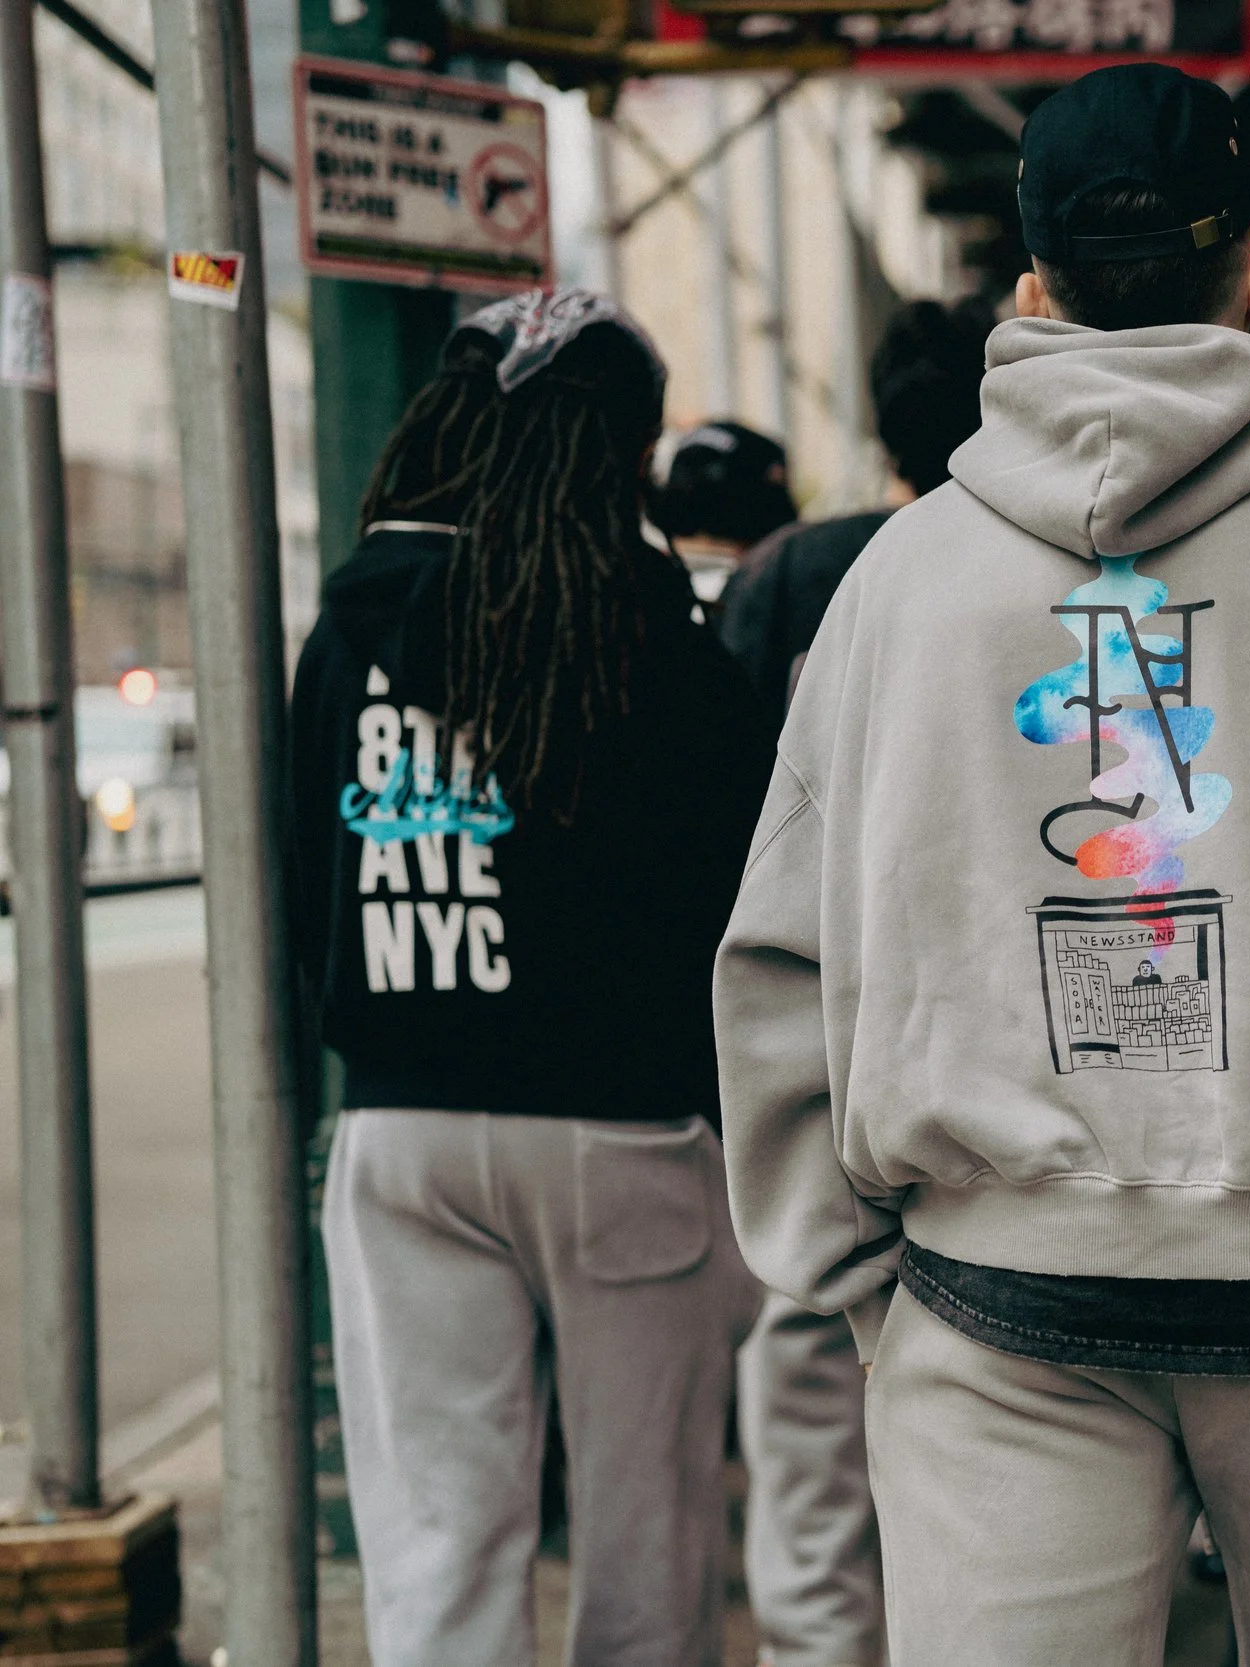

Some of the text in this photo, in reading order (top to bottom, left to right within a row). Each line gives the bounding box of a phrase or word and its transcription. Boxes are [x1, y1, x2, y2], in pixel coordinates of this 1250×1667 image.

[315, 111, 378, 144] THIS
[357, 803, 502, 898] AVE
[361, 901, 512, 993] NYC
[1079, 930, 1175, 947] NEWSSTAND
[1070, 977, 1083, 1024] SODA
[1093, 980, 1105, 1026] WATER
